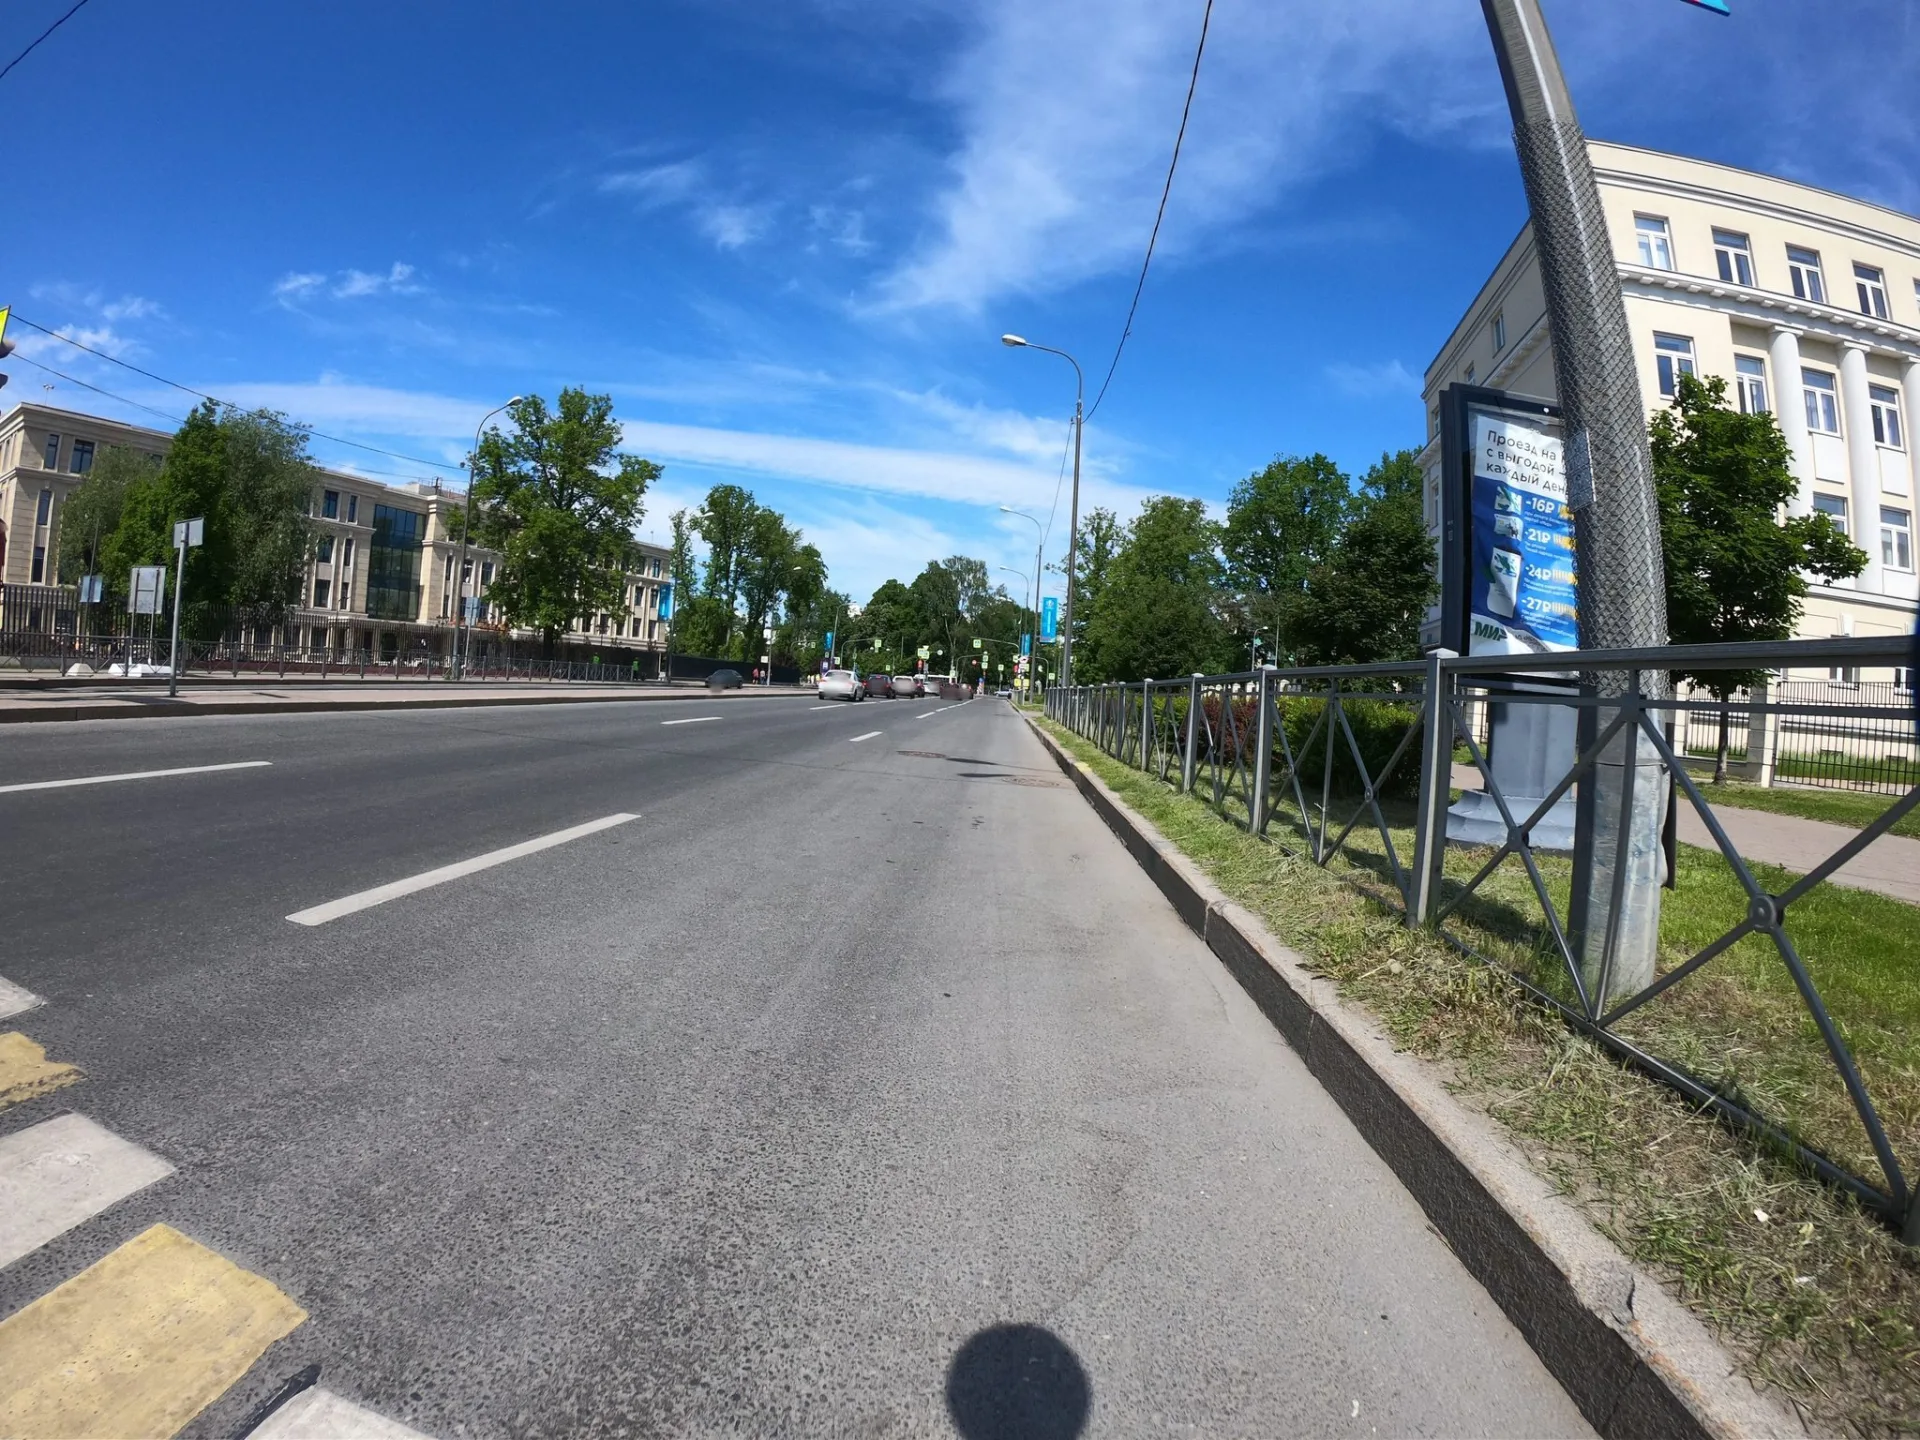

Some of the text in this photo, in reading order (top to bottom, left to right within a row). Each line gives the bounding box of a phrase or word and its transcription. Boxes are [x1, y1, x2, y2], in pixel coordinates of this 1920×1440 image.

[1487, 430, 1556, 461] Проезд на
[1486, 448, 1494, 458] с
[1497, 451, 1554, 476] выгодой
[1486, 463, 1567, 495] каждый ден
[1474, 621, 1508, 642] МИР
